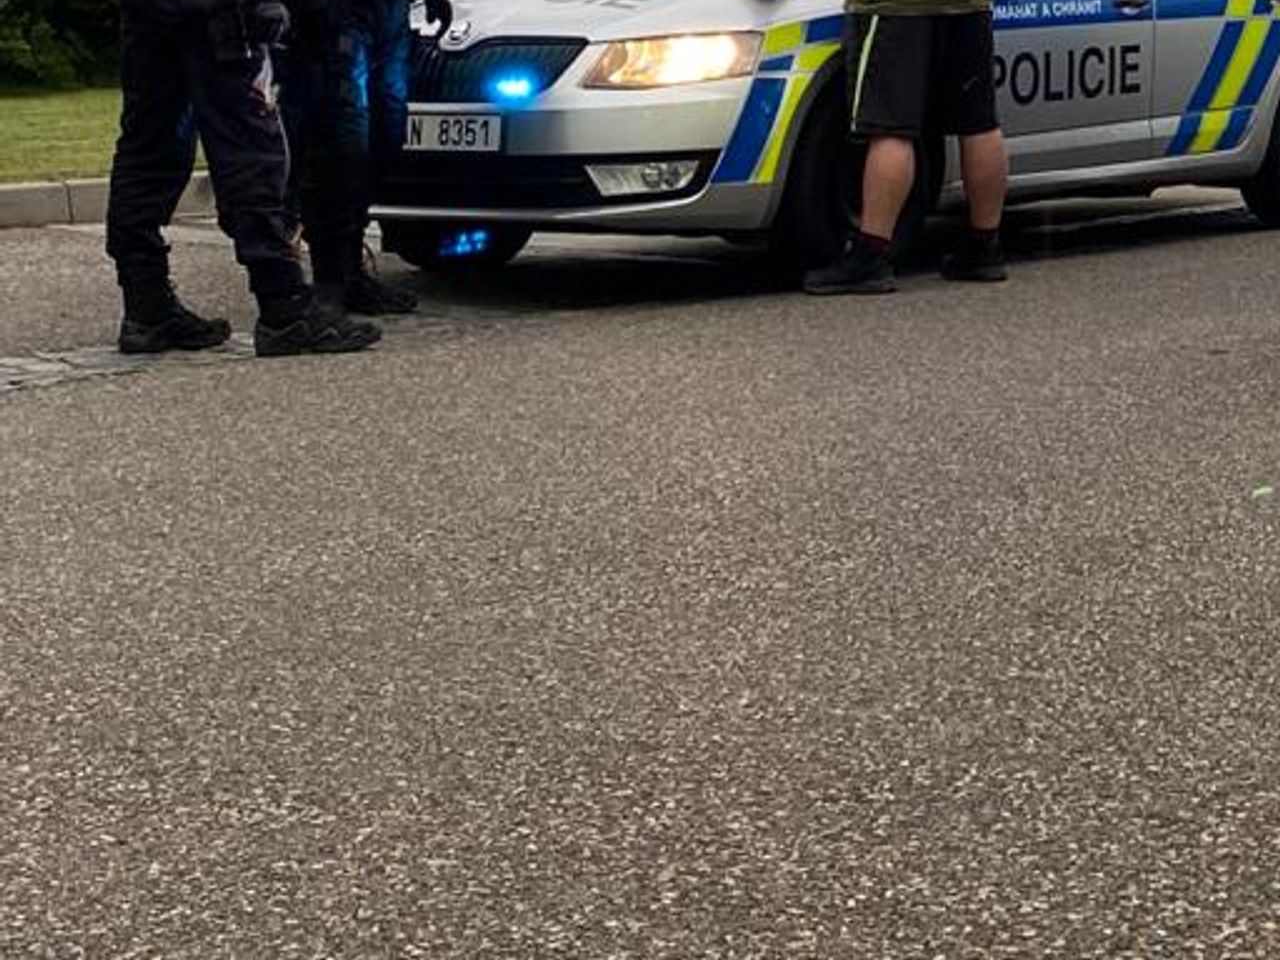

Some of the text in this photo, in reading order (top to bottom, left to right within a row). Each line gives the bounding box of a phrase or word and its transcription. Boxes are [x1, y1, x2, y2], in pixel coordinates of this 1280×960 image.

[992, 0, 1037, 20] MÁHAT
[1042, 3, 1051, 19] A
[409, 118, 490, 147] N 8351
